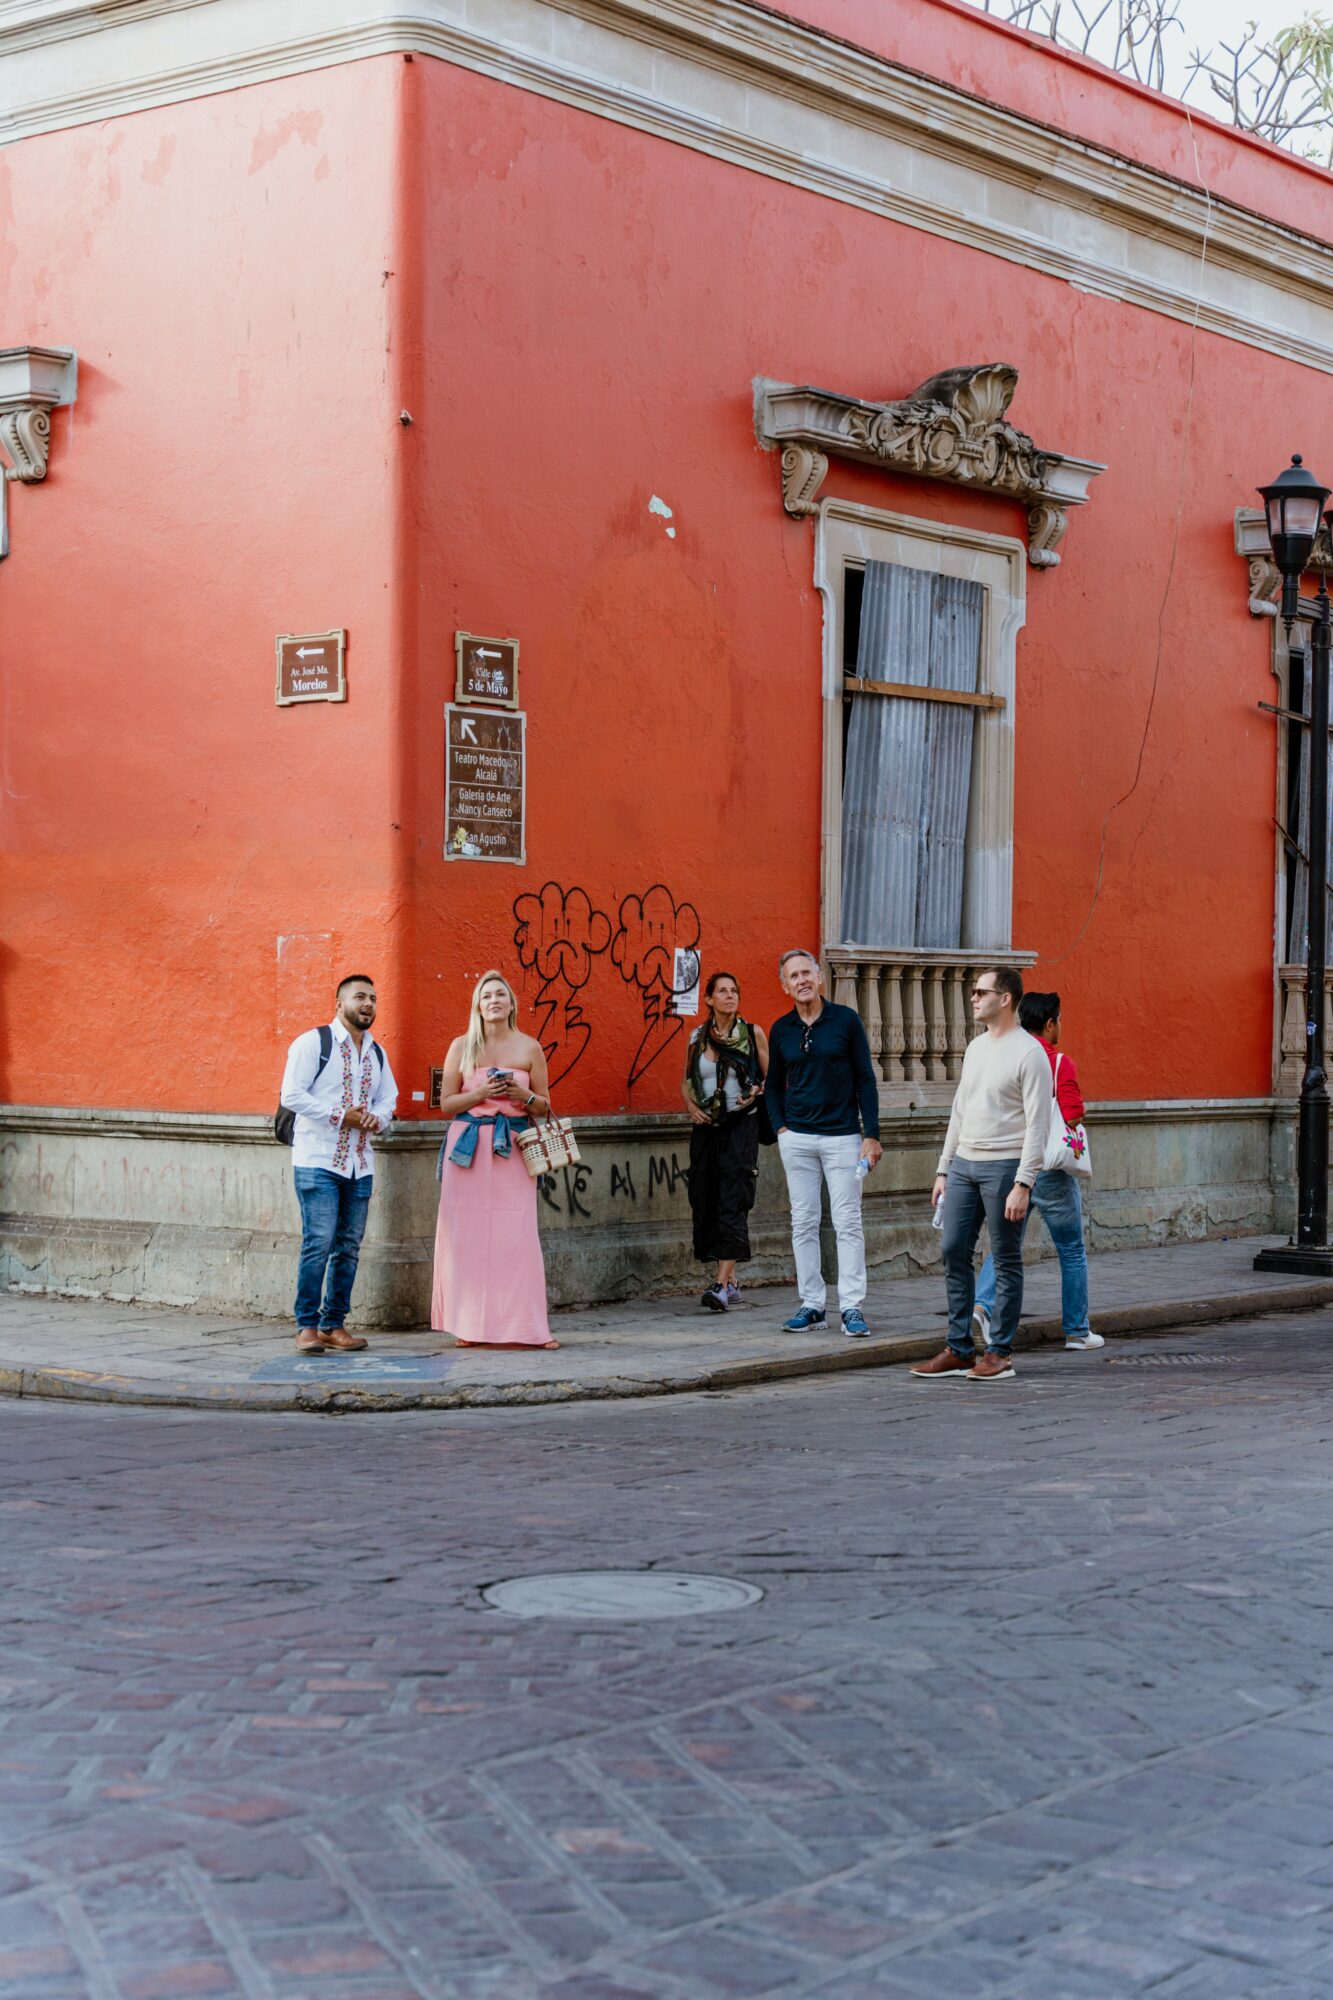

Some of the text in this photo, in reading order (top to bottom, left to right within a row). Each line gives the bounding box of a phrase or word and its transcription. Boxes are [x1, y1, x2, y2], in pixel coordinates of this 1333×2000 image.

[290, 665, 329, 677] Av. José Ma.
[292, 678, 328, 692] Morelos
[468, 678, 508, 697] 5 de Mayo
[455, 751, 518, 768] Teatro Macedo
[475, 768, 498, 781] Alcalá
[486, 790, 495, 802] de
[496, 791, 511, 803] Arte
[458, 803, 513, 817] Nancy Canseco
